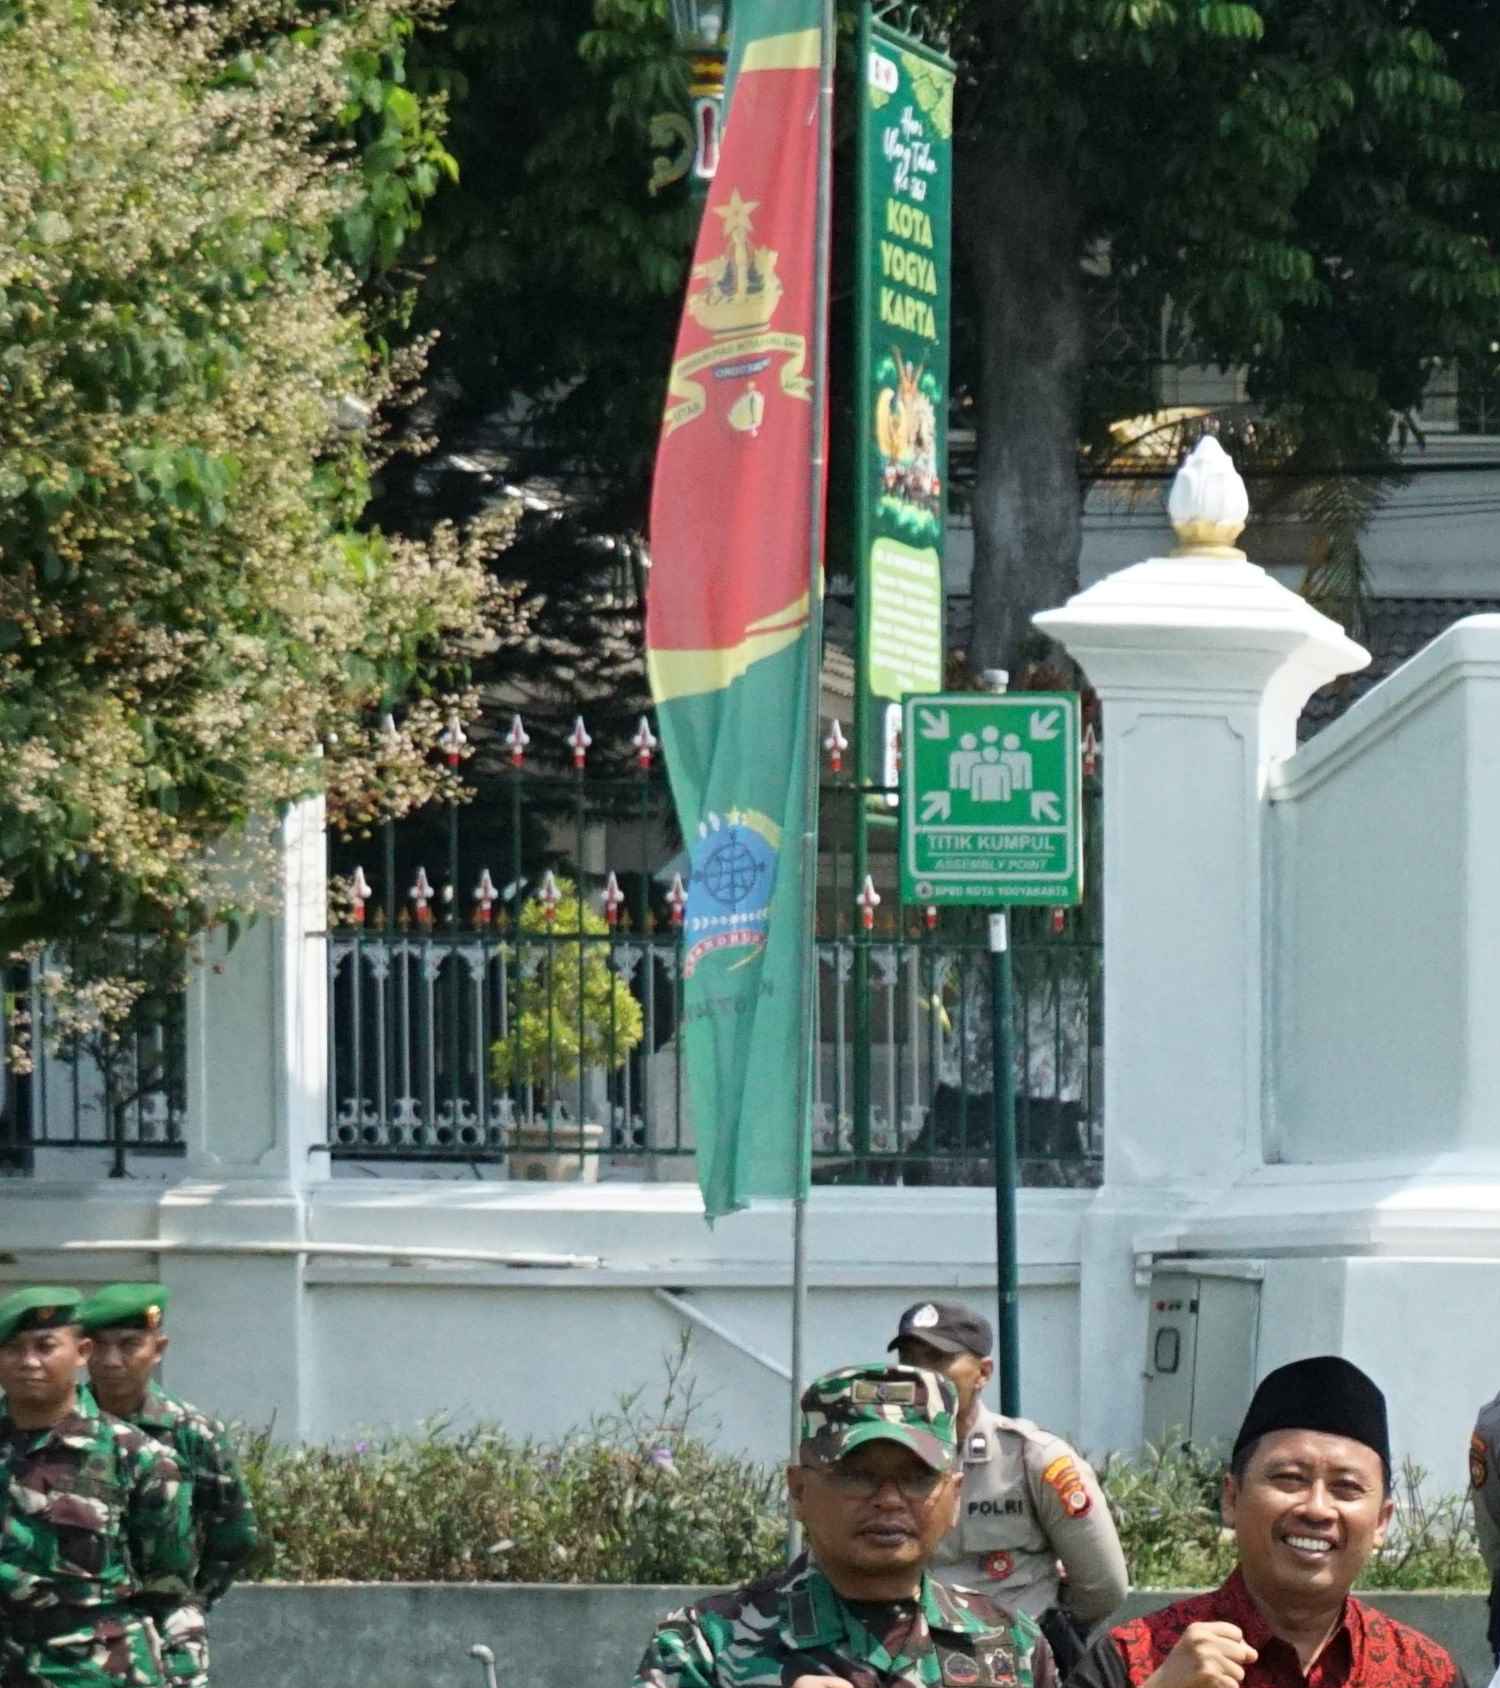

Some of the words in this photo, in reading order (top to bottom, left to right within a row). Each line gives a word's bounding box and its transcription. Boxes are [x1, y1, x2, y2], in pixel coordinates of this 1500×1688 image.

[887, 198, 934, 249] KOTA
[880, 240, 938, 296] YOGYA
[880, 286, 938, 341] KARTA
[927, 834, 971, 850] TITIK
[977, 834, 1056, 850] KUMPUL
[934, 858, 1004, 871] ASSEMBLY
[1007, 858, 1049, 870] POINT
[964, 886, 995, 897] KOTA
[998, 885, 1069, 897] YOGYAKARTA
[967, 1500, 1024, 1516] POLRI
